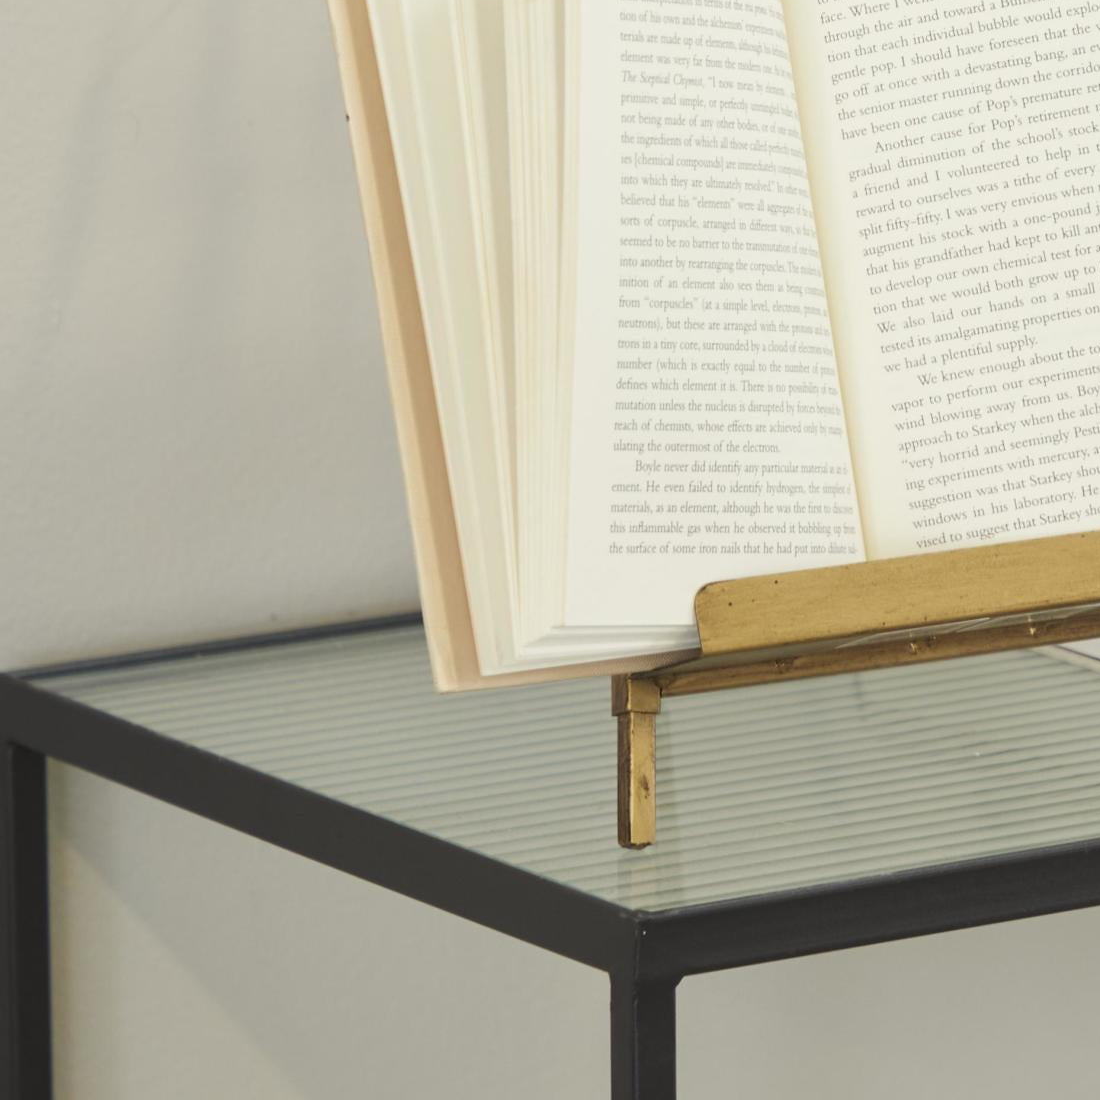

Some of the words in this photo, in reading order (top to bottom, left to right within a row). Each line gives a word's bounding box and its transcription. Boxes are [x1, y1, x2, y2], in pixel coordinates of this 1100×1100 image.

[848, 158, 892, 183] gradual
[896, 147, 967, 169] diminution
[971, 139, 986, 155] of
[991, 137, 1012, 151] the
[1016, 127, 1064, 147] school's
[1067, 120, 1100, 137] stock
[865, 262, 889, 277] that
[891, 258, 910, 271] his
[913, 243, 985, 270] grandfather
[987, 236, 1011, 253] had
[1013, 234, 1042, 249] kept
[1044, 232, 1058, 242] to
[1060, 223, 1081, 240] kill
[901, 456, 935, 469] "very
[938, 443, 980, 464] horrid
[983, 439, 1007, 456] and
[1009, 428, 1070, 450] seemingly
[905, 479, 926, 492] ing
[927, 464, 1004, 487] experiments
[1006, 454, 1035, 471] with
[1037, 448, 1091, 466] mercury,
[908, 490, 973, 511] suggestion
[975, 485, 999, 497] was
[1001, 478, 1026, 492] that
[1028, 470, 1073, 487] Starkey
[912, 510, 968, 529] windows
[972, 506, 986, 518] in
[990, 501, 1009, 515] his
[1012, 491, 1077, 511] laboratory.
[1080, 483, 1100, 498] He
[916, 531, 947, 549] vised
[949, 533, 963, 543] to
[965, 523, 1011, 541] suggest
[1012, 517, 1037, 531] that
[1038, 508, 1083, 526] Starkey
